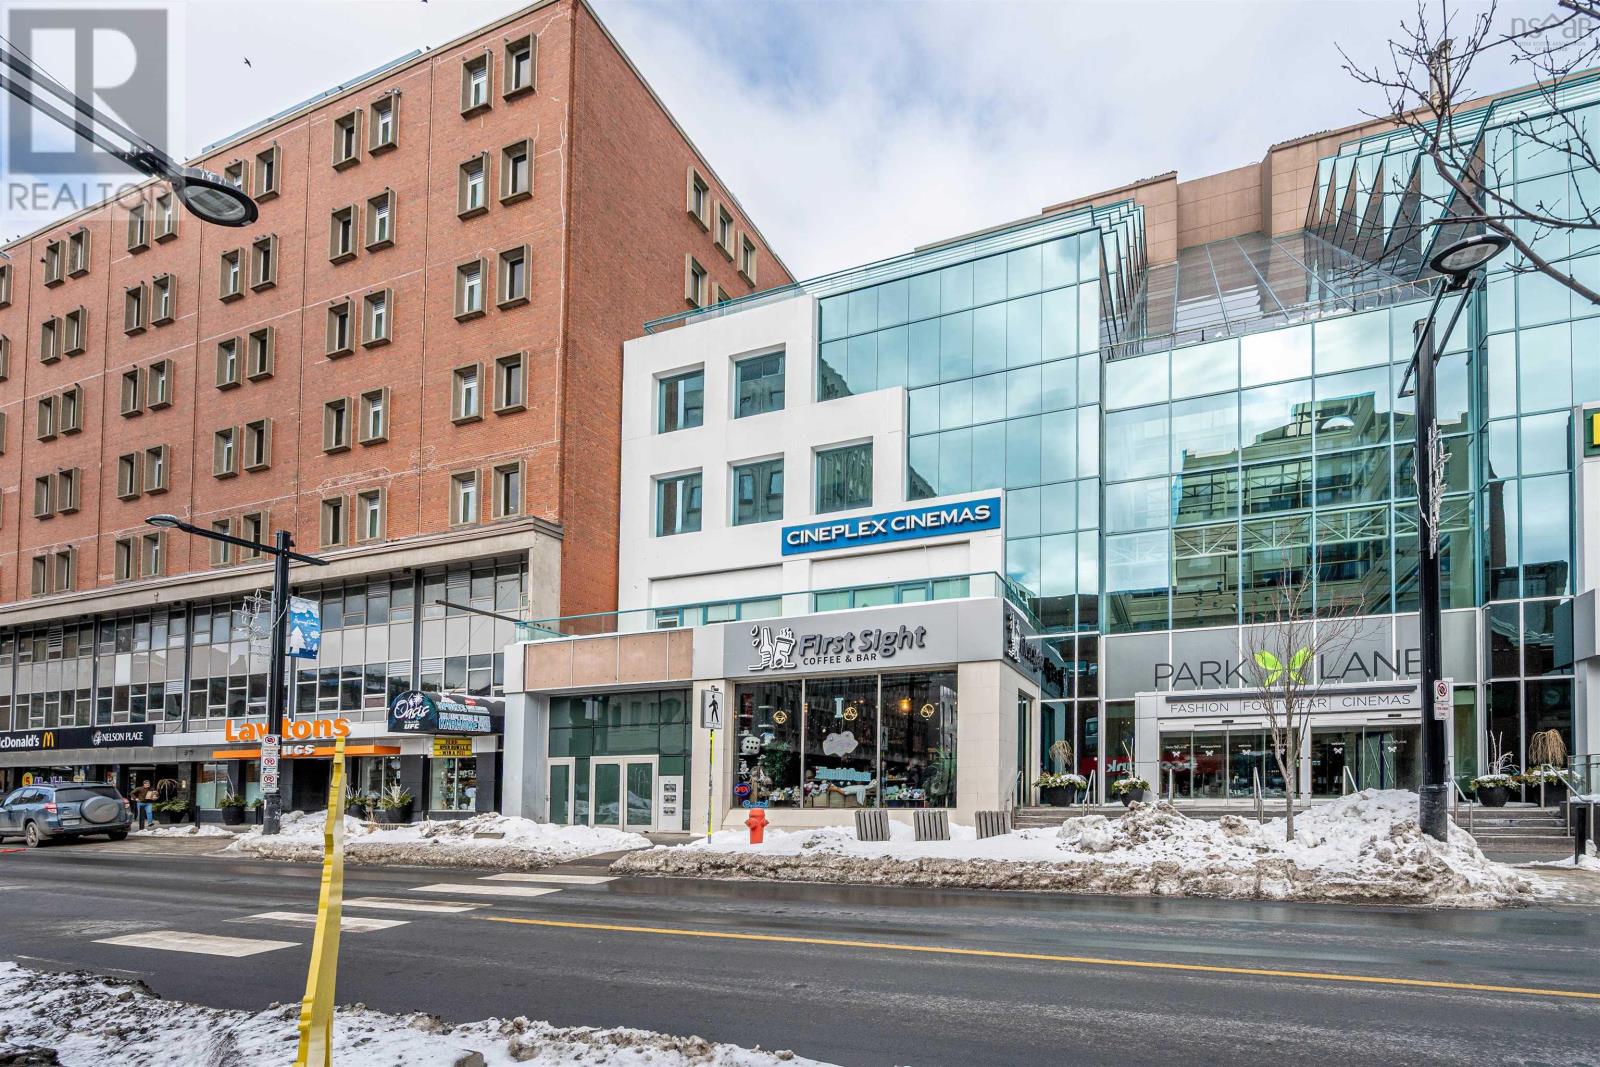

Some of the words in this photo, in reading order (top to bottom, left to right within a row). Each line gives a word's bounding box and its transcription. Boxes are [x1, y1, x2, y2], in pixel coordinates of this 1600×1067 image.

[786, 518, 888, 546] CINEPLEX
[890, 504, 991, 532] CINEMAS
[798, 631, 856, 658] First
[857, 624, 927, 658] Sight
[803, 655, 842, 667] COFFEE
[845, 654, 853, 663] &
[856, 652, 877, 663] BAR
[1154, 658, 1249, 688] PARK
[1320, 647, 1421, 680] LANE
[393, 699, 430, 720] Oasis
[1170, 702, 1230, 714] FASHION
[1243, 697, 1327, 712] FOOTWEAR
[1341, 694, 1411, 709] CINEMAS
[0, 734, 40, 749] cDonald's
[101, 732, 124, 743] NELSON
[125, 731, 144, 742] PLACE
